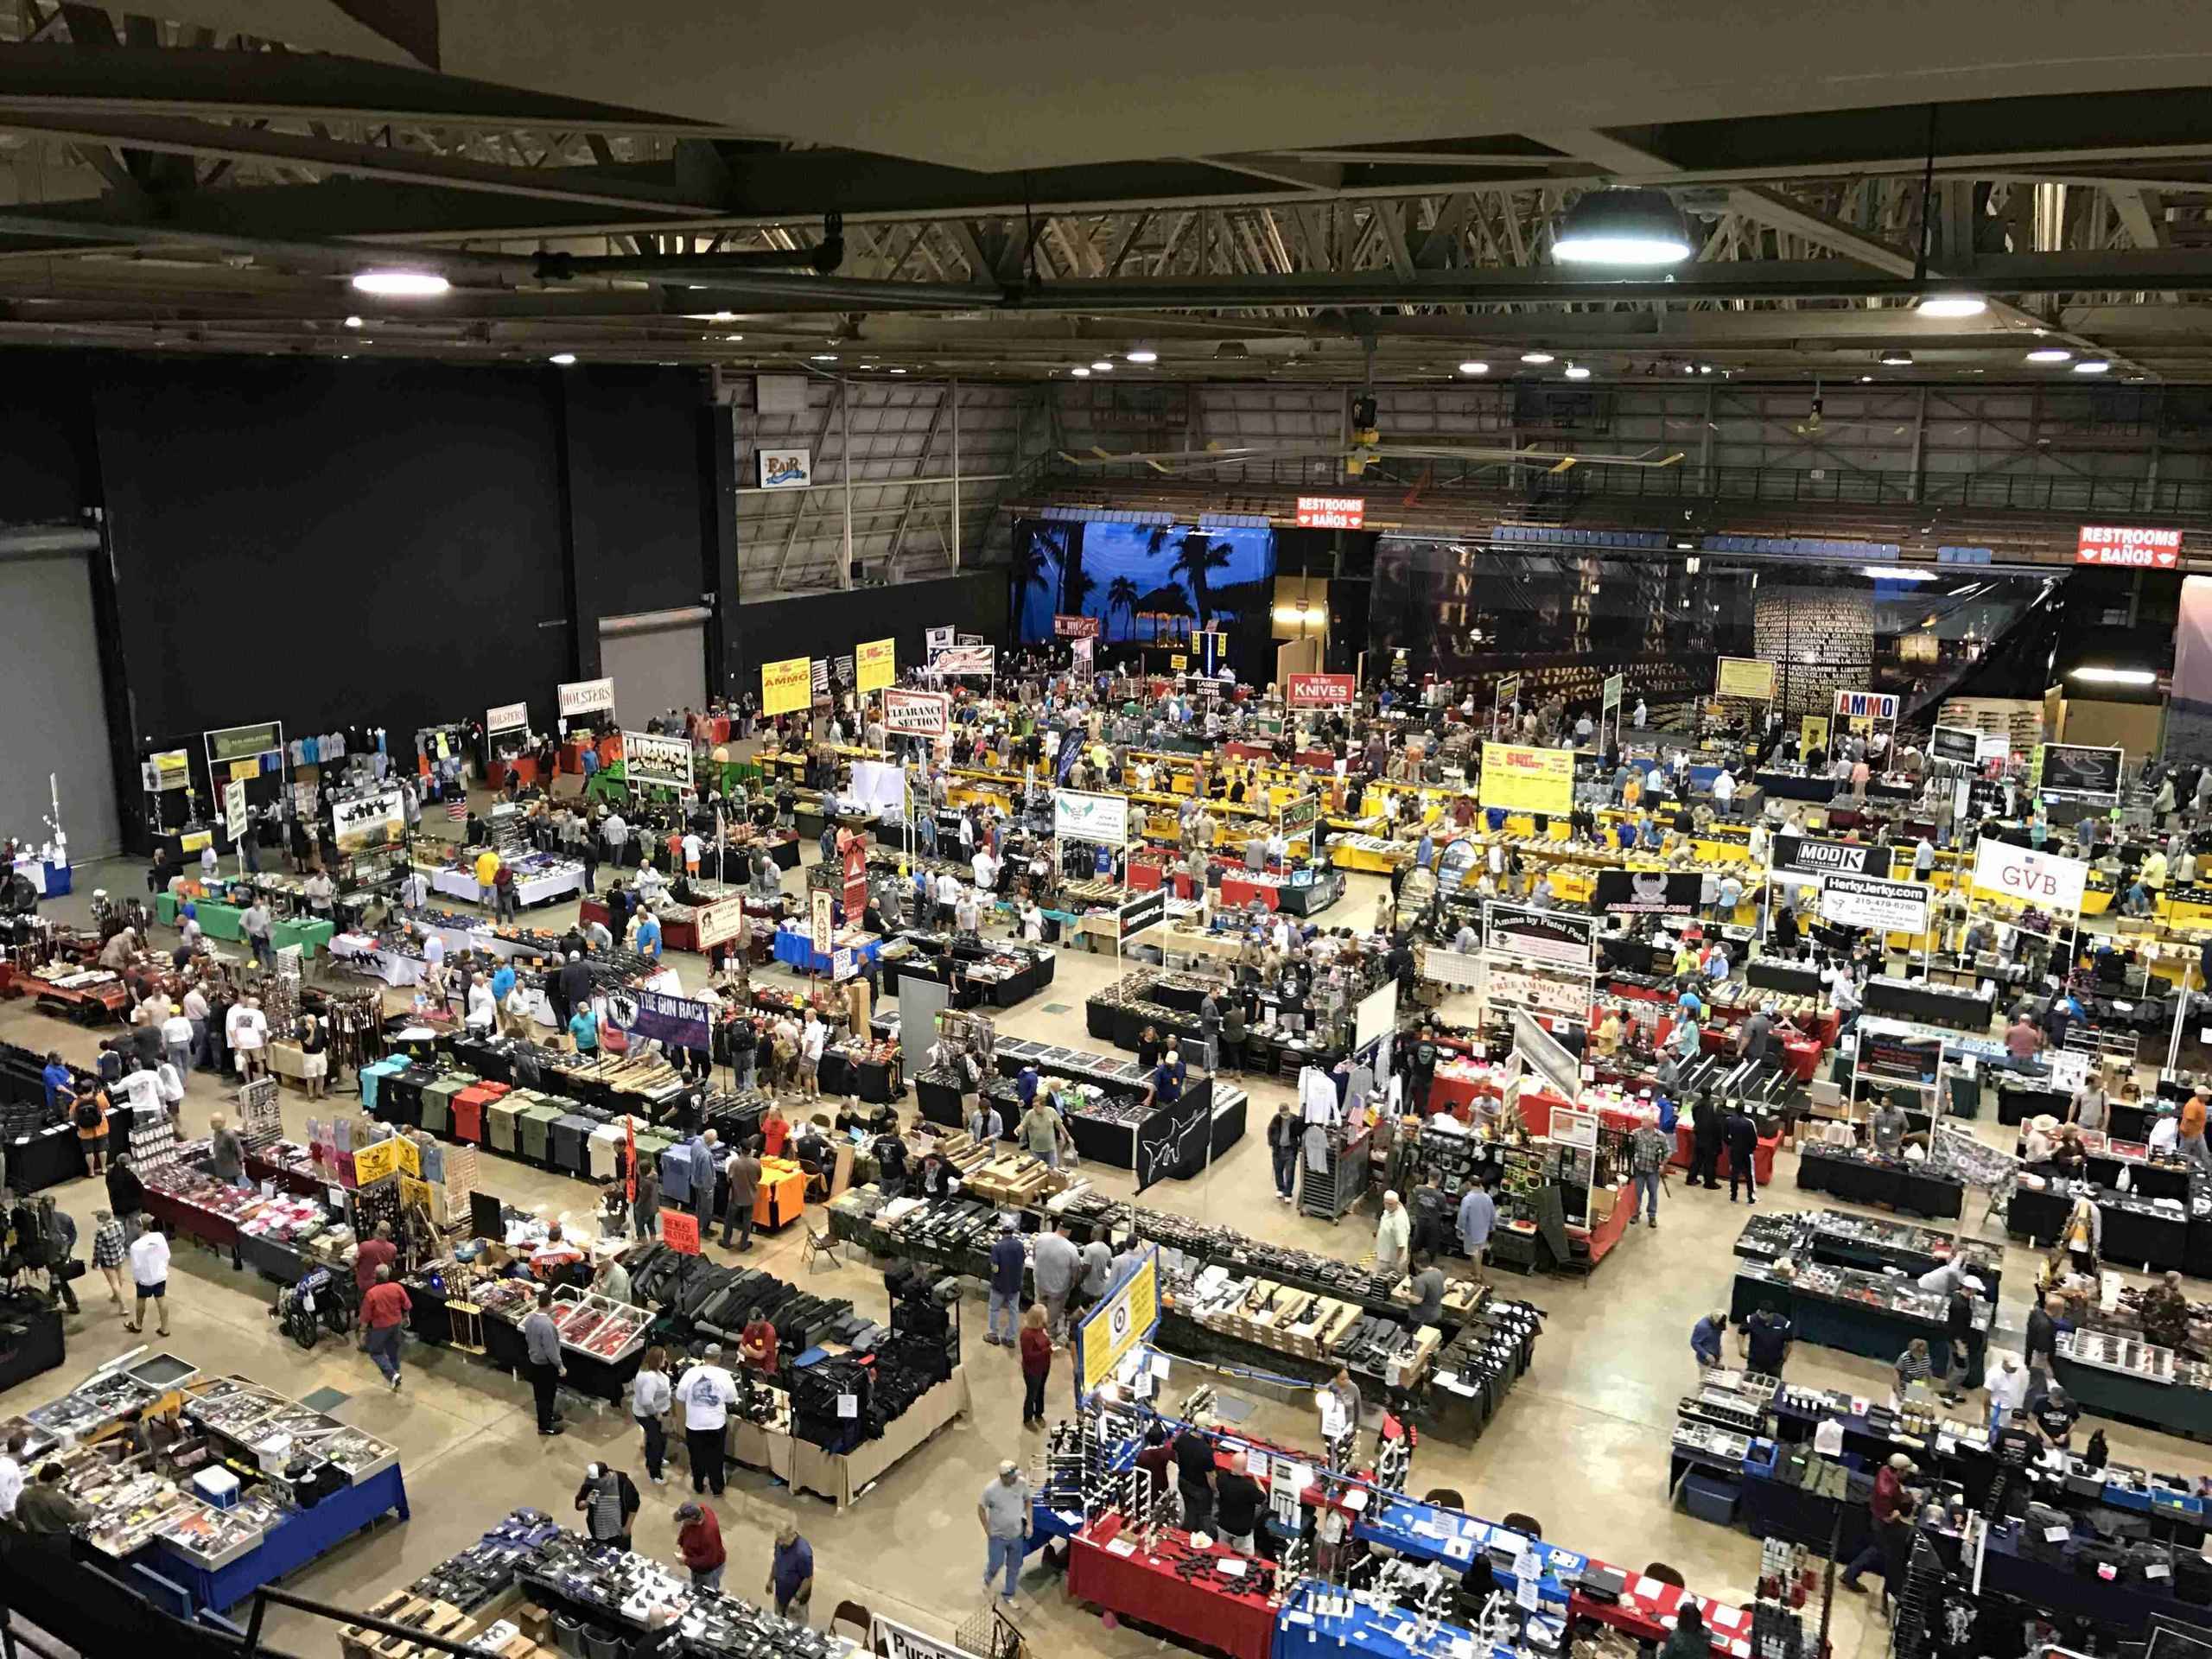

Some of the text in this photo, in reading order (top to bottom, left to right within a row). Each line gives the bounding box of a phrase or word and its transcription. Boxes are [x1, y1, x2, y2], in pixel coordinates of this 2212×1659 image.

[1299, 498, 1363, 512] RESTROOMS
[1312, 511, 1347, 526] BAÑOS
[2082, 526, 2179, 546] RESTROOMS
[2101, 544, 2154, 565] BAÑOS
[765, 674, 810, 688] AMMO
[1197, 680, 1220, 689] LASERS
[1294, 683, 1348, 697] KNIVES
[563, 685, 611, 706] HOLSTERS
[1196, 688, 1220, 696] SCOPES
[887, 706, 941, 718] CLEARANCE
[1839, 694, 1894, 718] AMMO
[898, 717, 940, 727] SECTION
[626, 738, 687, 766] AIRSOFT
[1801, 844, 1841, 862] MOD
[1829, 877, 1923, 899] HerkyJerky.com
[2002, 866, 2056, 895] GVB
[1494, 915, 1586, 943] Ammo by Pistol Pete
[834, 969, 850, 982] SALE
[639, 992, 657, 1012] THE
[658, 995, 677, 1018] GUN
[678, 1001, 706, 1023] RACK
